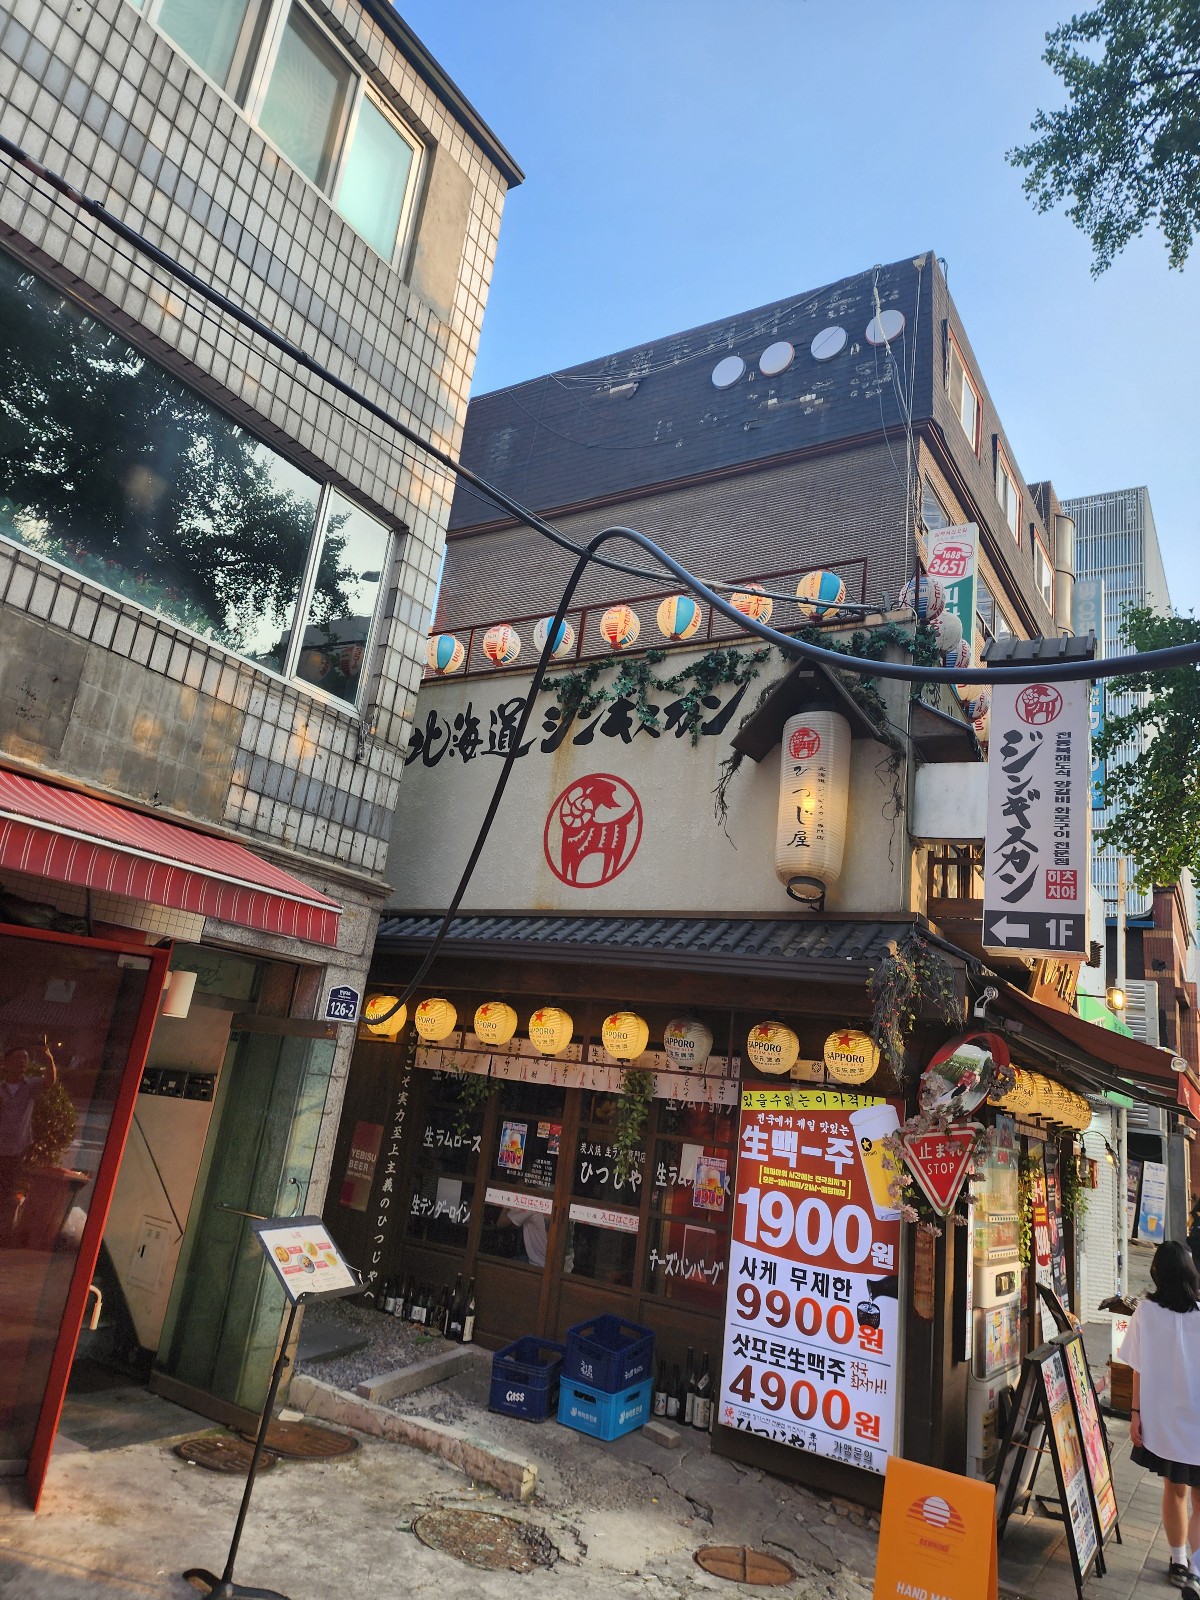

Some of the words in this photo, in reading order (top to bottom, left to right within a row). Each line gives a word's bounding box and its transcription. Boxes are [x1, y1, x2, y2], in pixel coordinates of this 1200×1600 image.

[942, 550, 961, 559] 1688
[930, 558, 966, 575] 3651
[1054, 731, 1071, 777] 전통북해도식
[1053, 780, 1072, 803] 양갈비
[787, 765, 811, 848] ひつじ屋
[993, 729, 1044, 904] ジンギスカン
[1053, 806, 1070, 839] 화로구이
[1053, 841, 1070, 866] 전문점
[1048, 870, 1075, 884] 히츠
[1048, 885, 1076, 899] 지야
[1045, 919, 1075, 946] 1F
[331, 1001, 355, 1017] 126-2
[820, 1121, 850, 1136] 맛있는
[423, 1126, 482, 1153] 生ラムロース
[349, 1160, 369, 1172] BEER
[352, 1148, 377, 1163] YEBISU
[927, 1162, 955, 1175] STOP
[410, 1193, 471, 1224] 生テンダーロイン
[649, 1249, 724, 1287] チーズハンバーグ
[738, 1255, 777, 1286] 사케
[789, 1266, 852, 1303] 무제한
[732, 1332, 846, 1385] 삿포로生맥주
[850, 1361, 869, 1377] 전국
[506, 1390, 525, 1402] Cass
[850, 1376, 887, 1395] 최저가!!
[834, 1440, 873, 1465] 가맹문의
[896, 1580, 928, 1600] HAND
